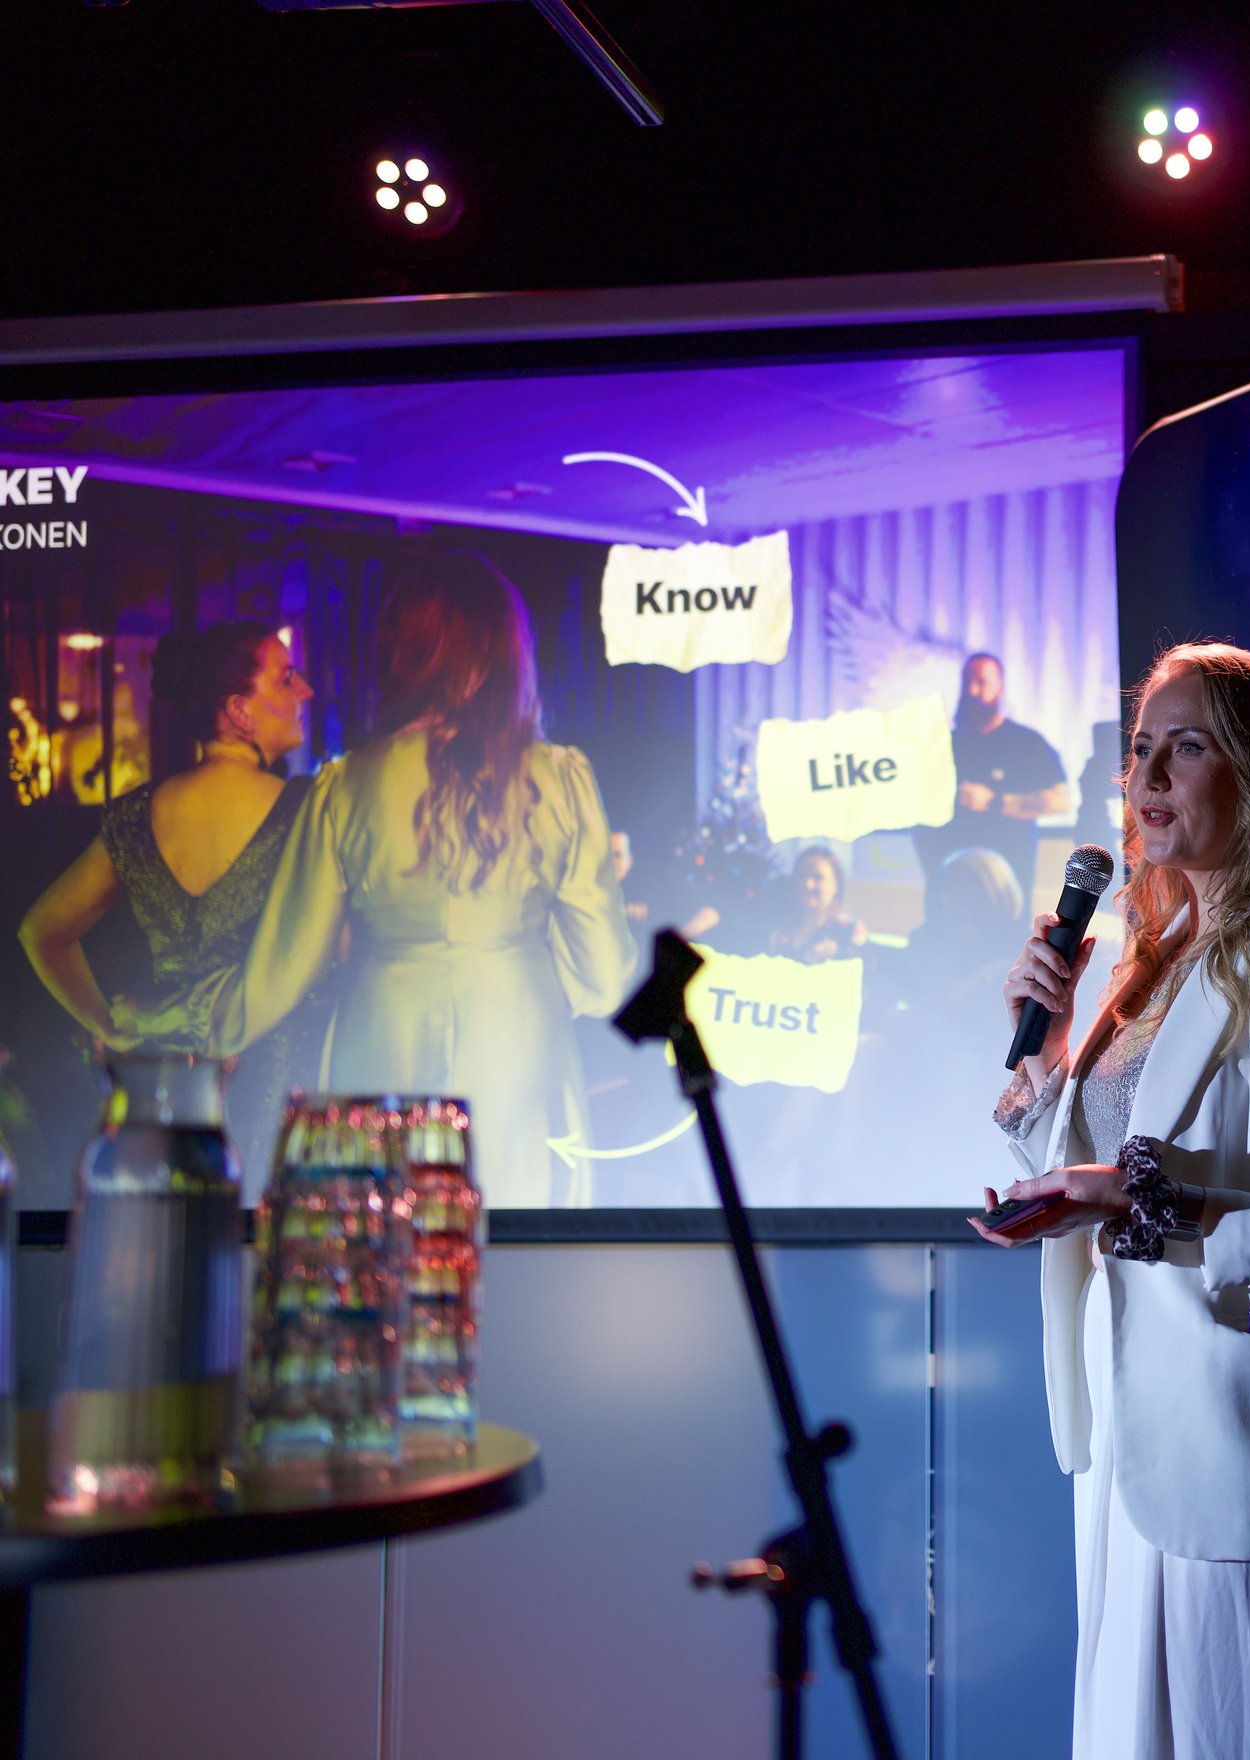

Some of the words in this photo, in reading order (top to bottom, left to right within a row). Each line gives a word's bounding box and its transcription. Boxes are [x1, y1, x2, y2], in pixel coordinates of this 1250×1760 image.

[0, 465, 89, 507] KEY
[635, 581, 757, 616] Know
[808, 752, 898, 793] Like
[707, 986, 822, 1036] Trust
